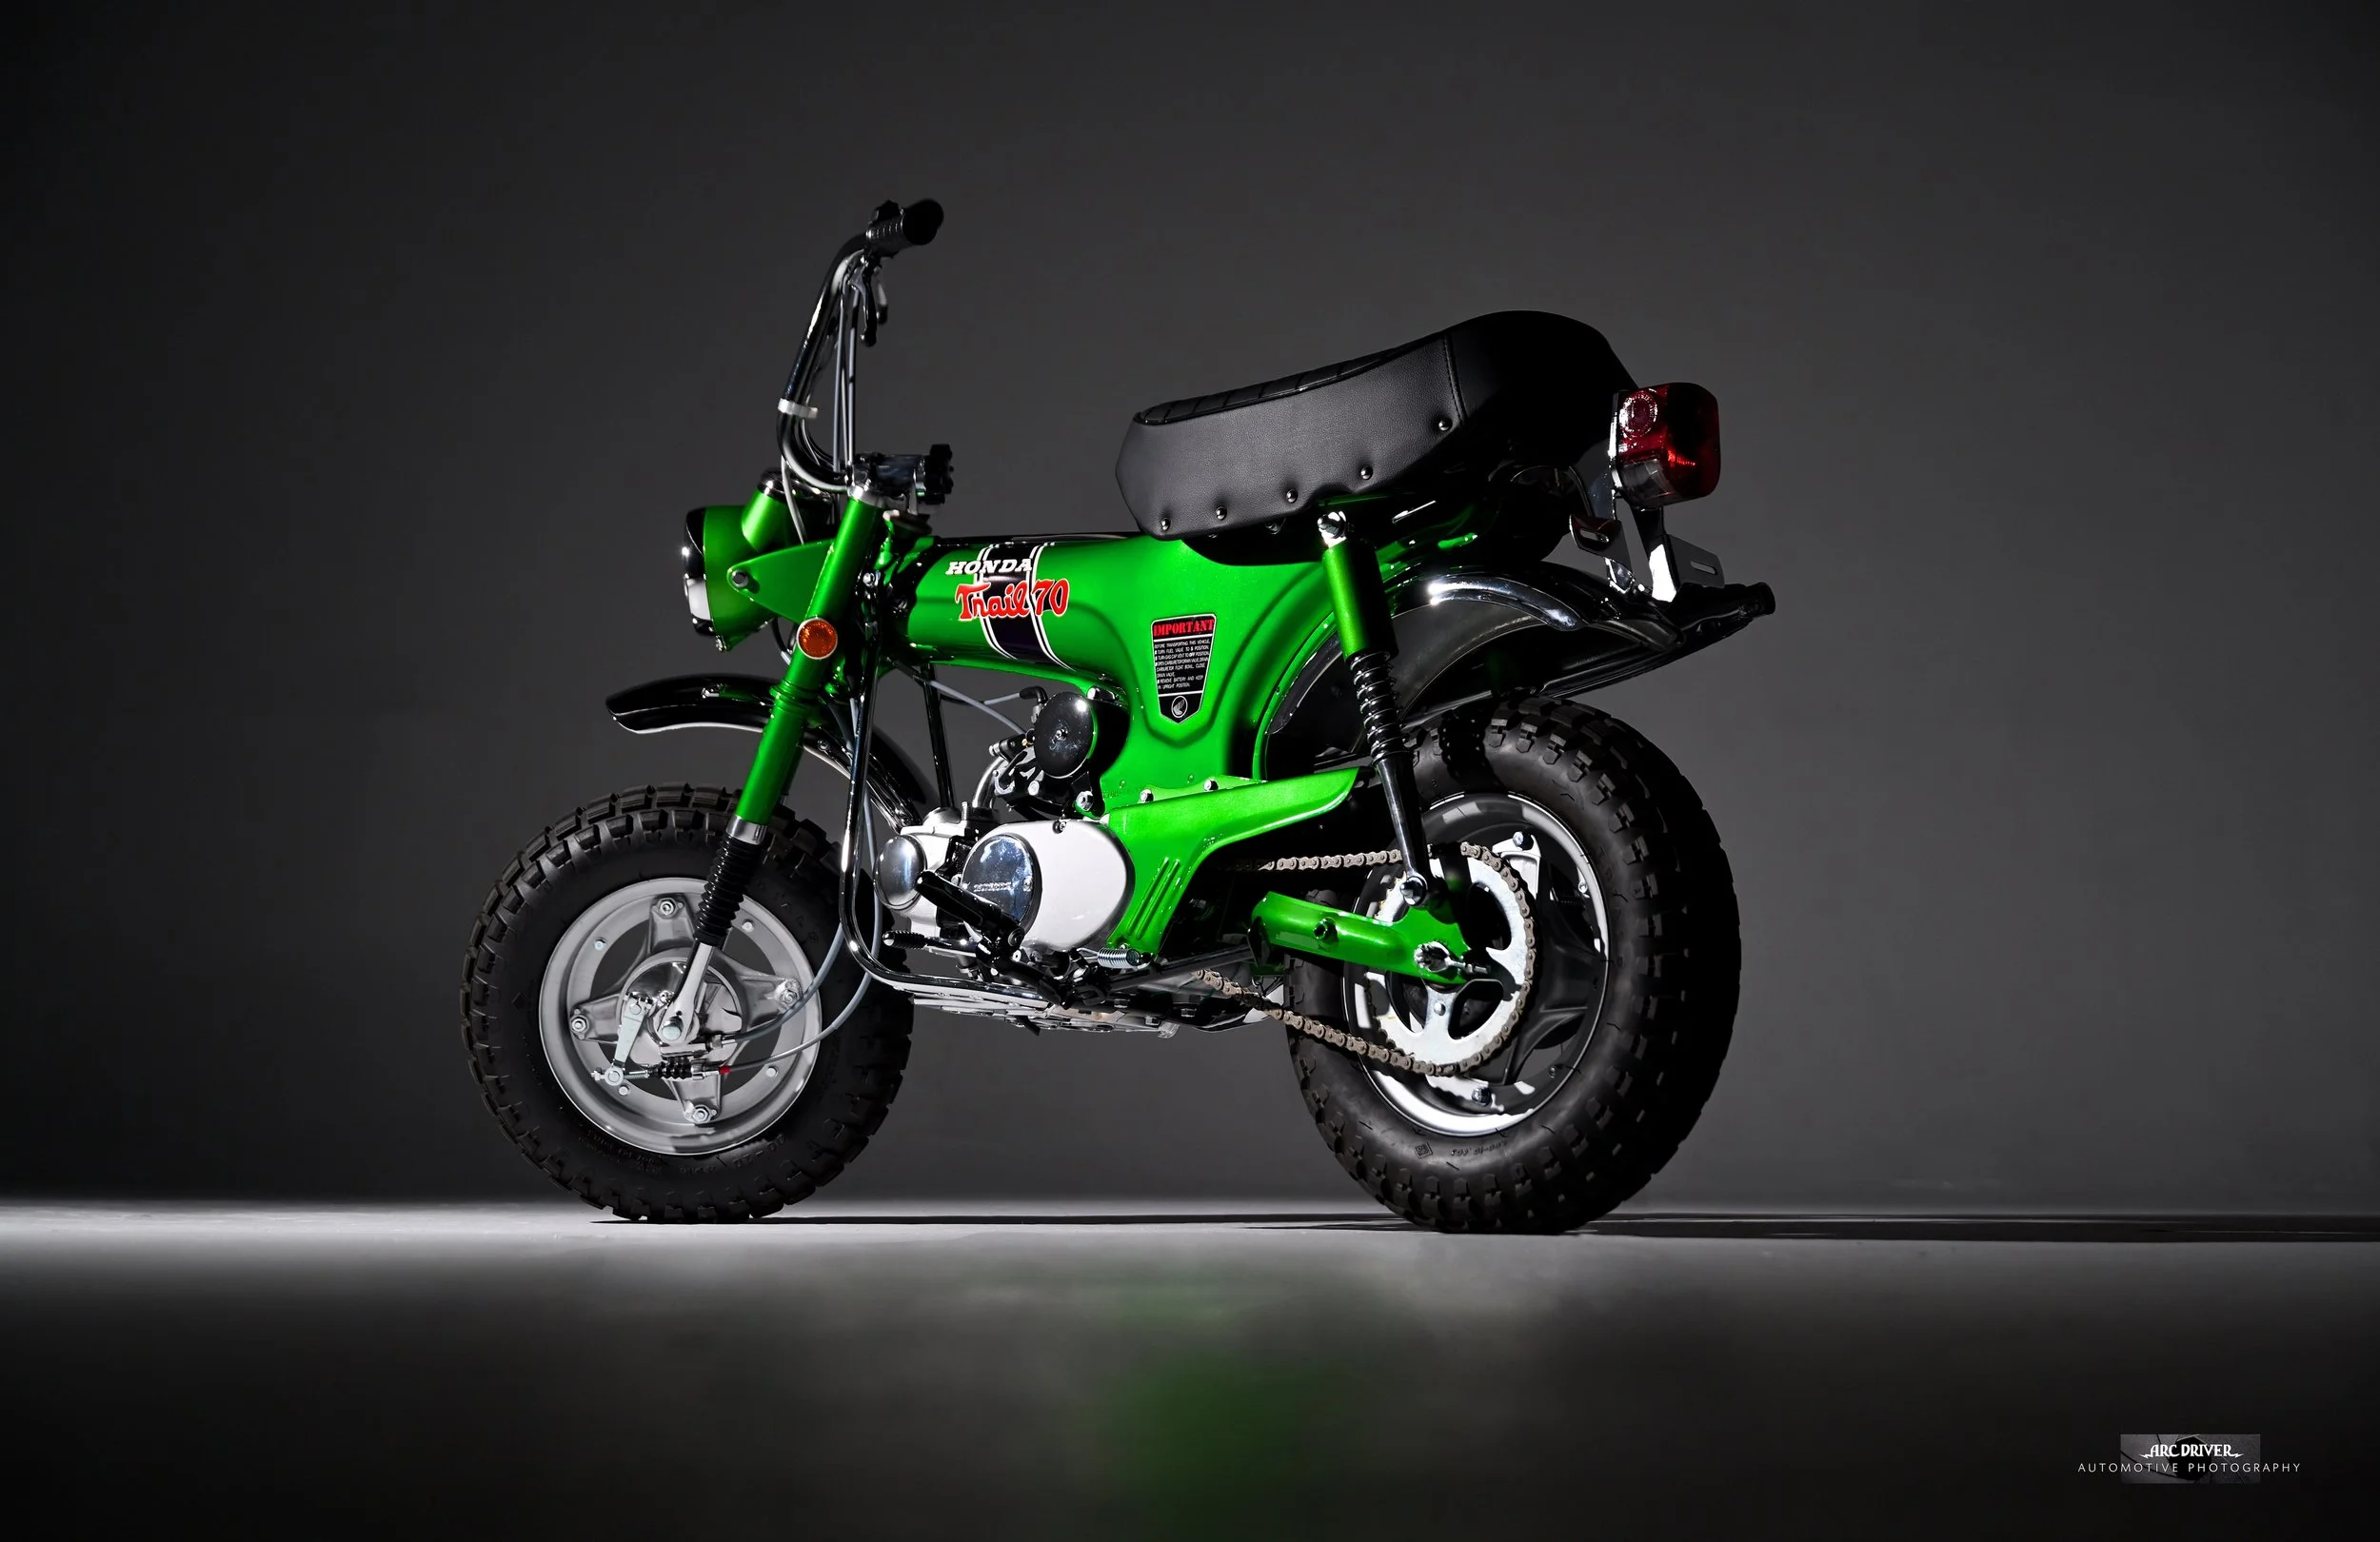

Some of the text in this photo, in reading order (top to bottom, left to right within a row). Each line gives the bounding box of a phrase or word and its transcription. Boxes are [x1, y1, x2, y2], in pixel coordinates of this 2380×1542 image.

[945, 558, 1033, 576] HONDA
[955, 578, 1070, 622] Trail 70
[1153, 619, 1215, 637] IMPORTANT
